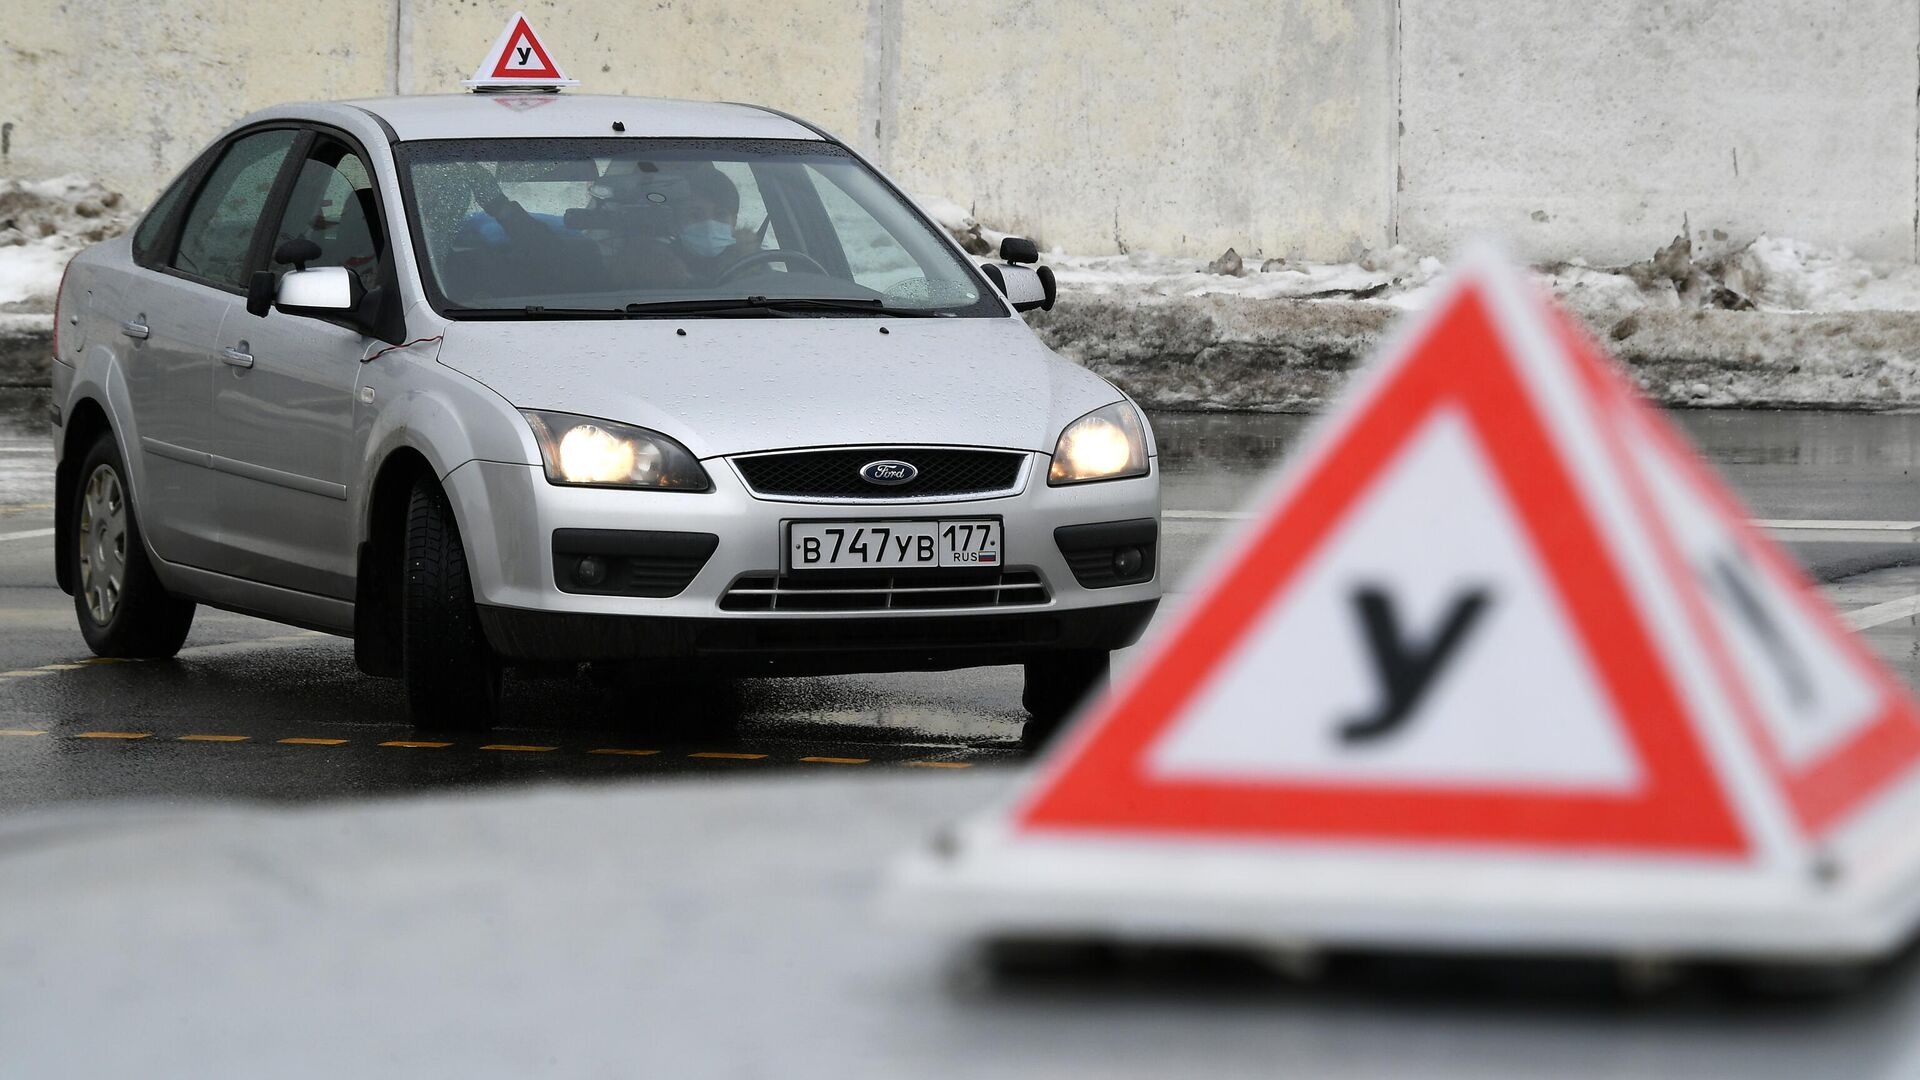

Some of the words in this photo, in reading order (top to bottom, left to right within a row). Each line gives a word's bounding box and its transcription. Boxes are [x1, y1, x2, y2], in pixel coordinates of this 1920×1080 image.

[516, 47, 532, 65] У
[874, 464, 905, 479] Ford
[942, 525, 991, 551] 177
[953, 552, 978, 562] RUS
[1338, 582, 1494, 745] У
